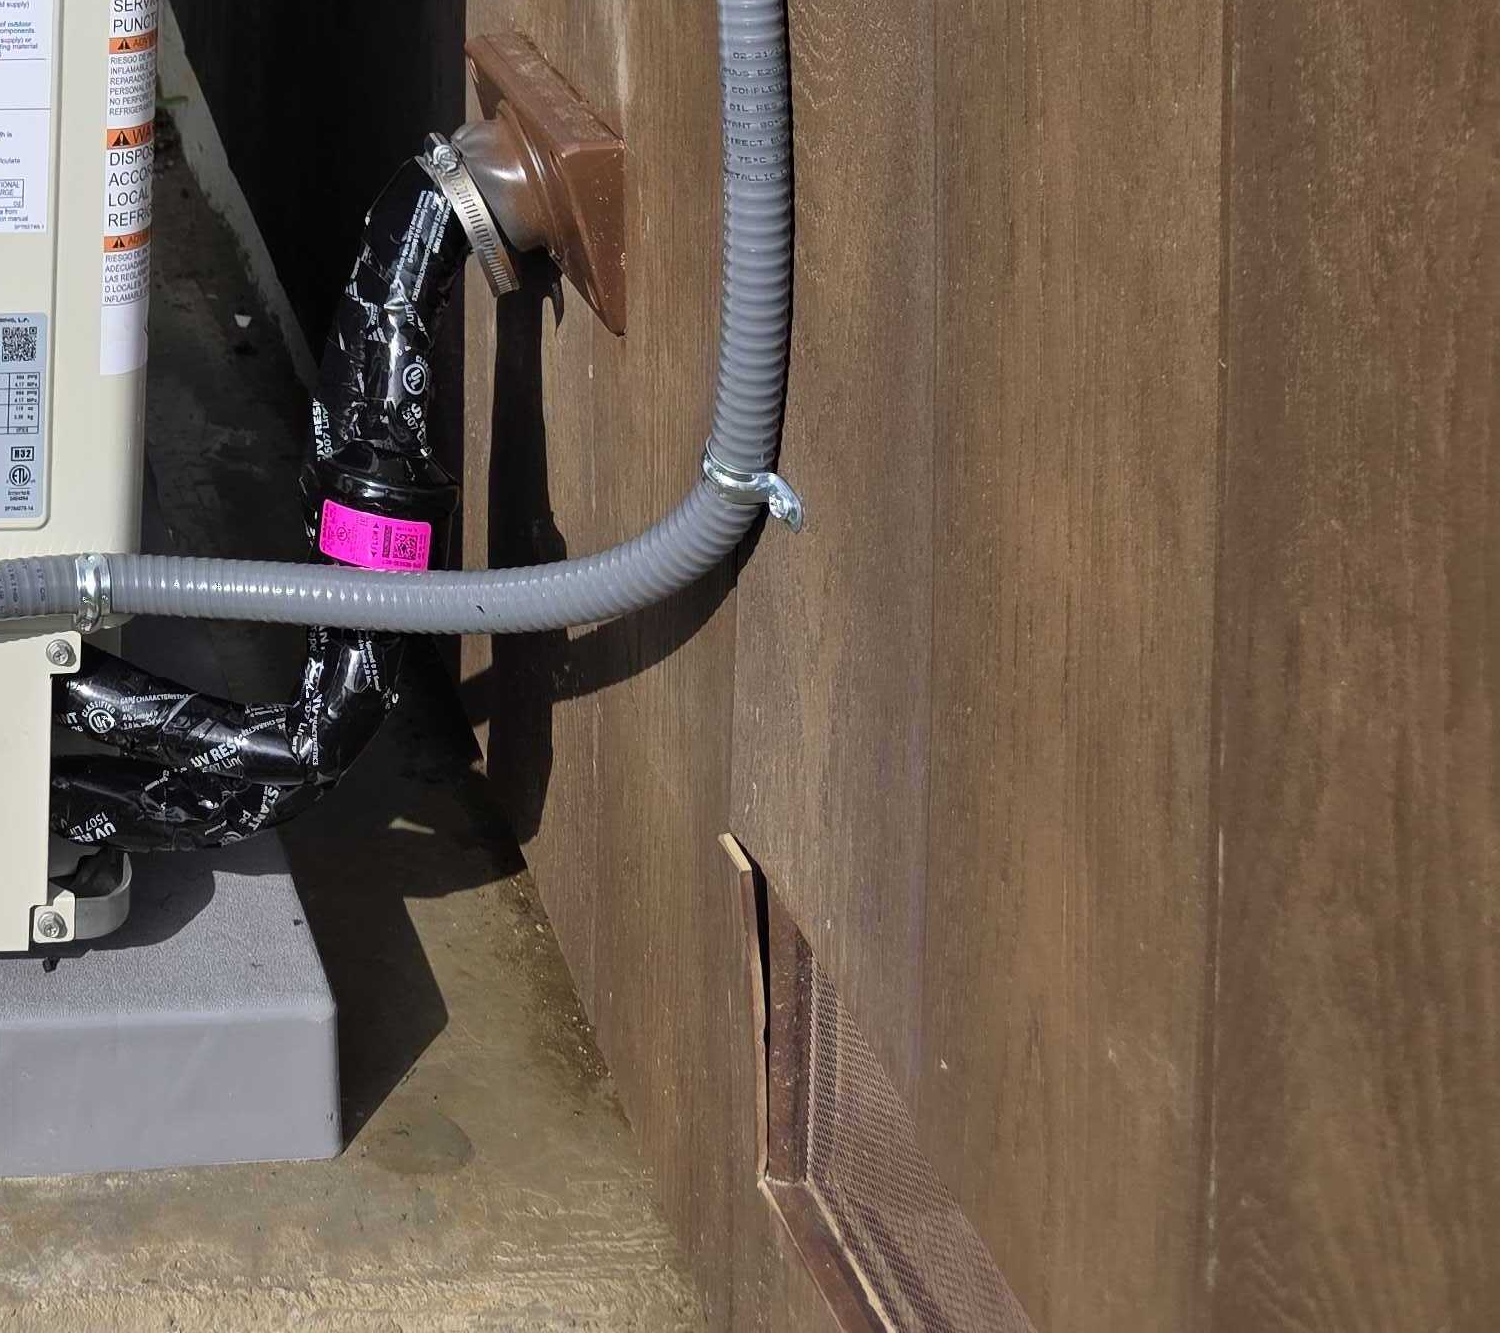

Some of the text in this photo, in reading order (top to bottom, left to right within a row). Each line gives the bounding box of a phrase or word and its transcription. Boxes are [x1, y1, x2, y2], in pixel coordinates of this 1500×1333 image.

[105, 275, 118, 283] LAS
[87, 811, 109, 831] 1507
[97, 821, 117, 842] UV
